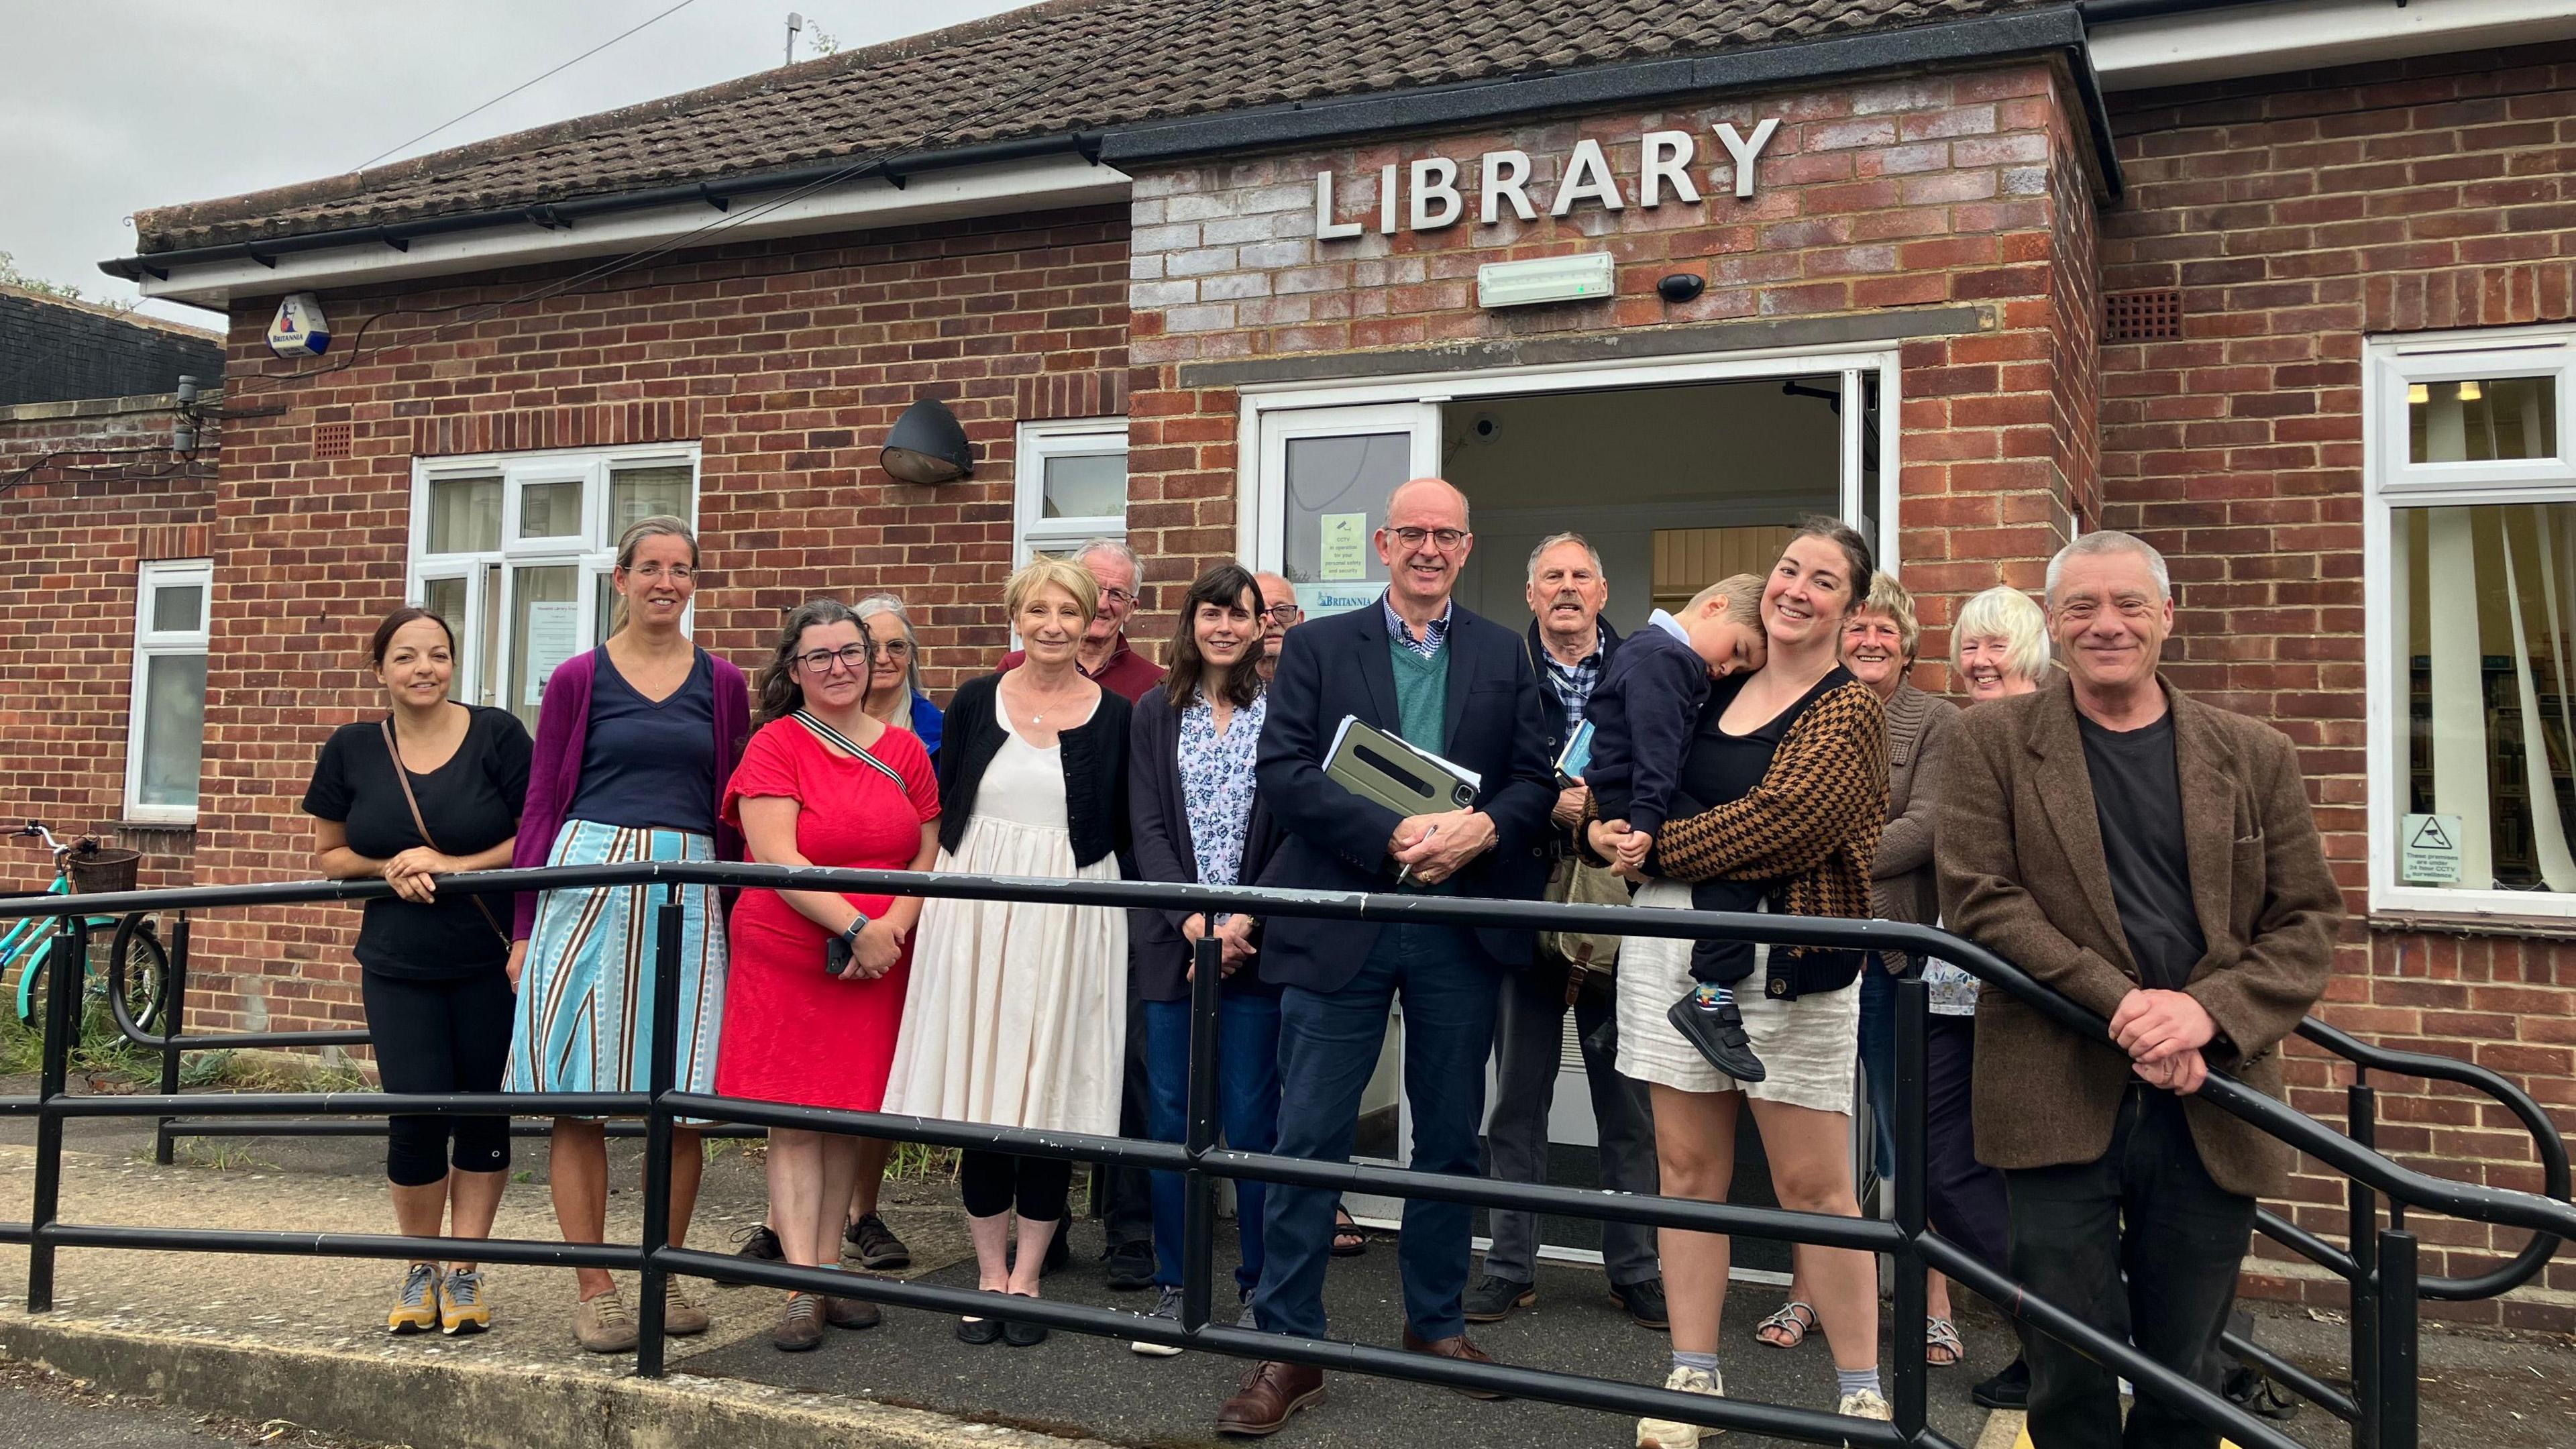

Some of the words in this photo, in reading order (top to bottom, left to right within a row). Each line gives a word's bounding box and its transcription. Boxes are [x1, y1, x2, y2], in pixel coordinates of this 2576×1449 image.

[1316, 117, 1782, 240] LIBRARY
[273, 334, 303, 342] BRITANNIA
[1327, 596, 1371, 606] BRITANNIA
